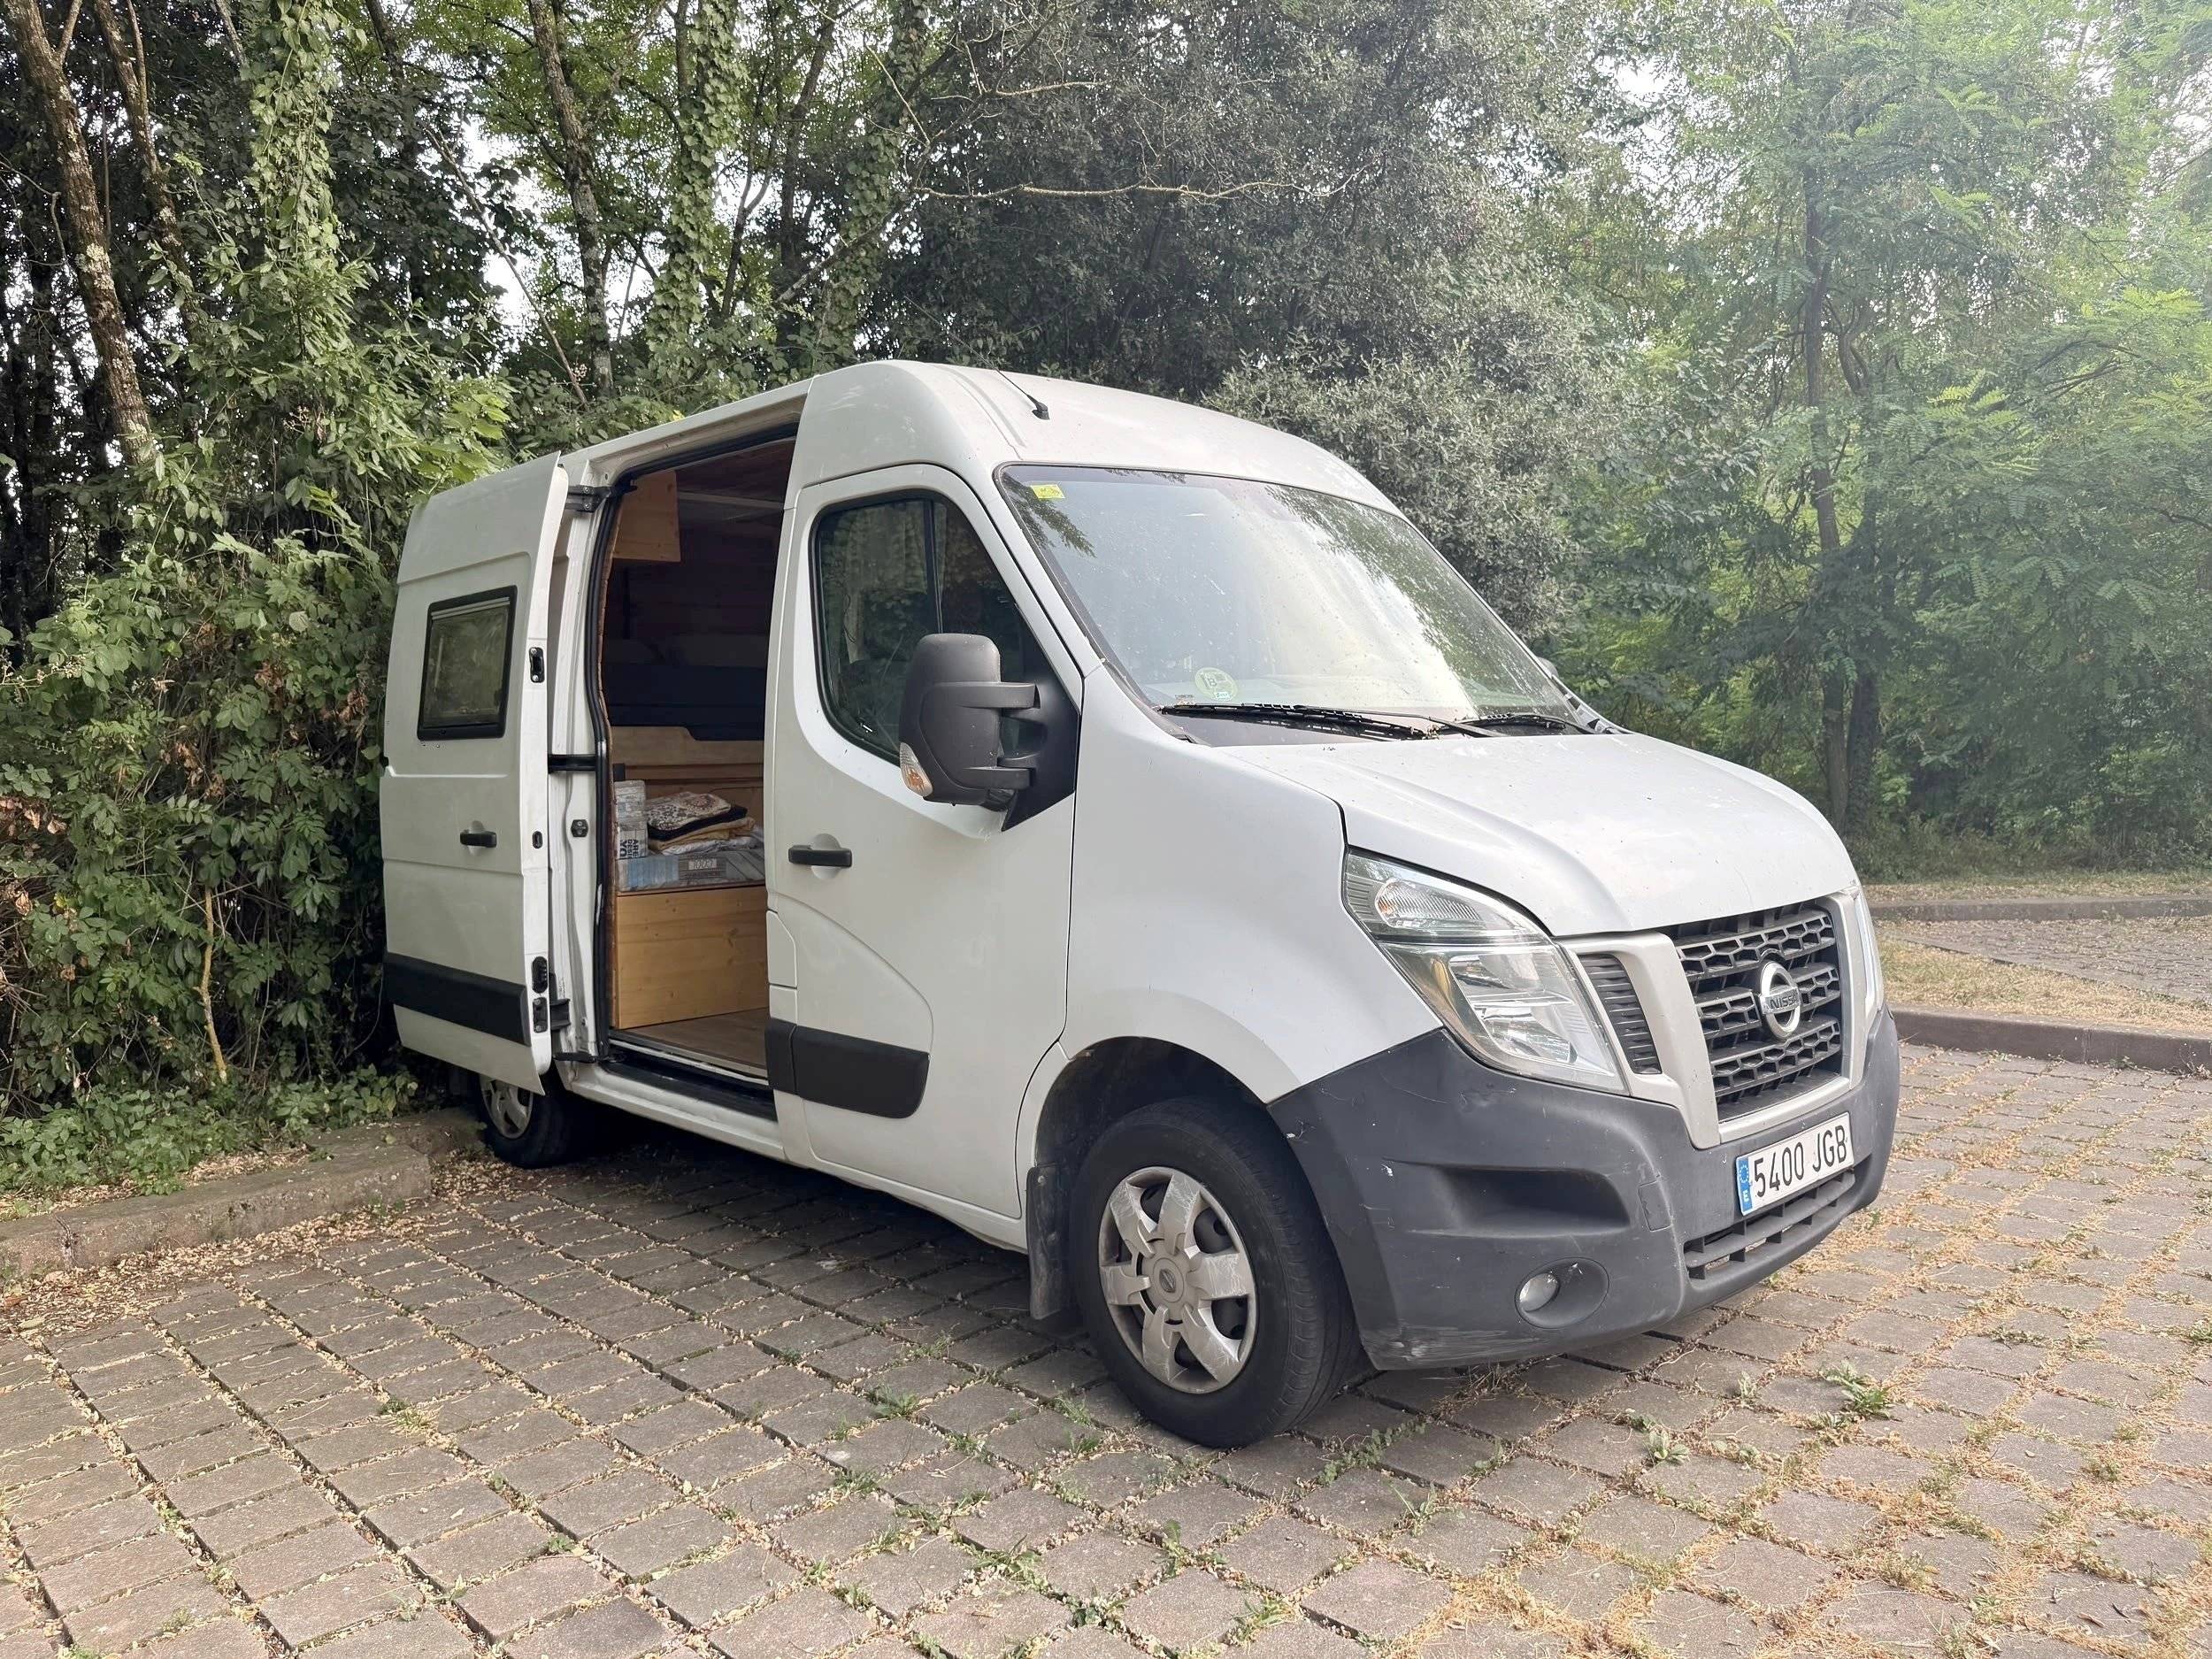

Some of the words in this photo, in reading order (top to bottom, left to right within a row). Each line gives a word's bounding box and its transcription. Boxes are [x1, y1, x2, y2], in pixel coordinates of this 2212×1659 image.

[1768, 993, 1798, 1010] NISSA
[1754, 1141, 1805, 1197] 5400
[1812, 1125, 1847, 1172] JGB
[1742, 1190, 1750, 1202] E
